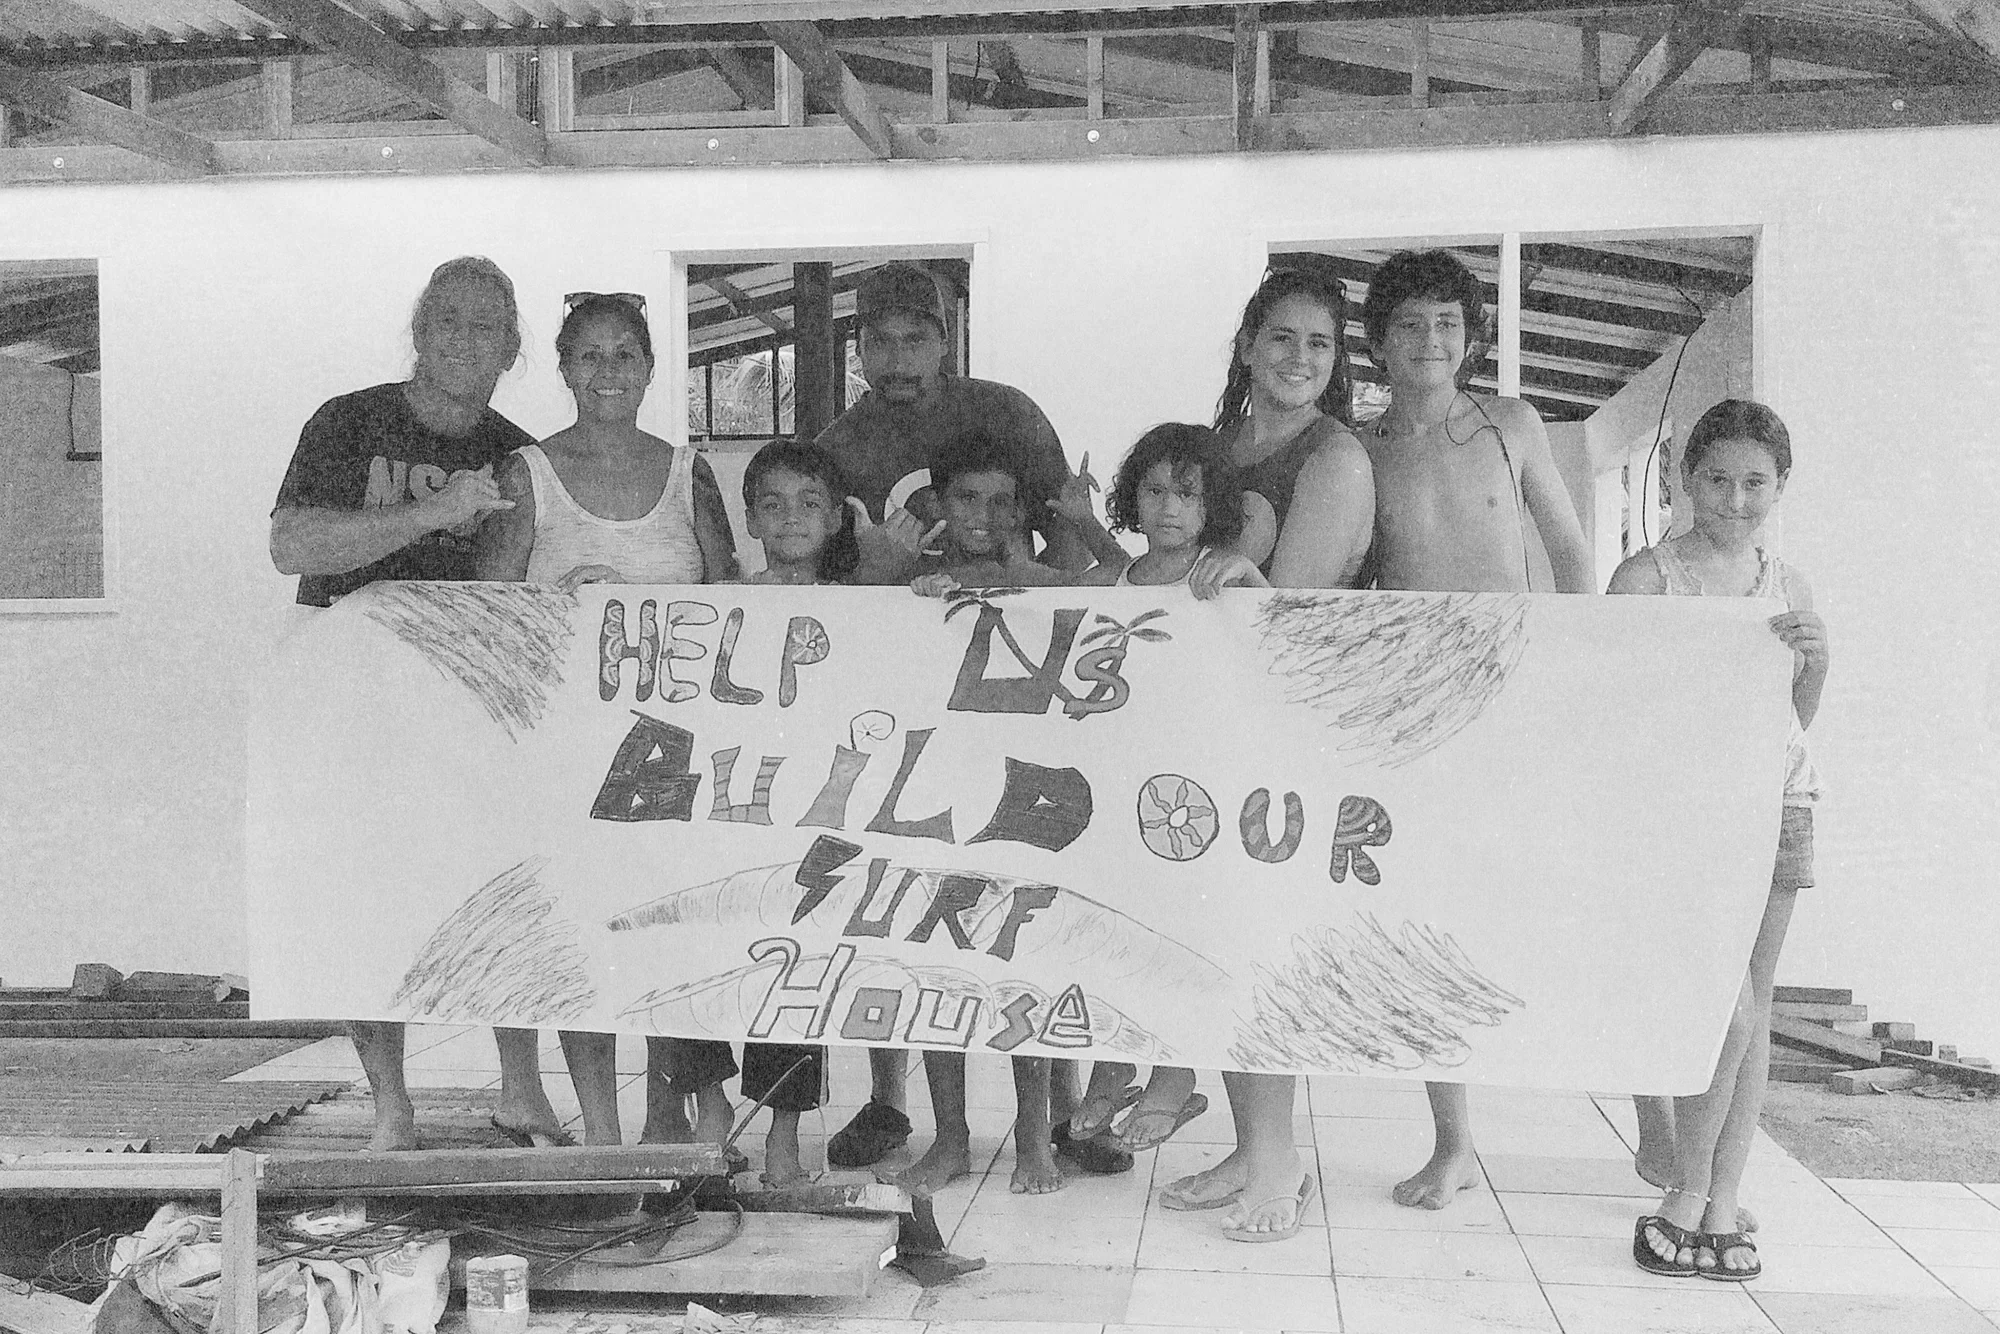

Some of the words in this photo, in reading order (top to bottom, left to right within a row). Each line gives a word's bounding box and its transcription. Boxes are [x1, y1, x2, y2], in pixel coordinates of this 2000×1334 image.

[599, 599, 831, 707] HELP
[946, 604, 1130, 720] US
[1137, 773, 1393, 886] OUR
[791, 834, 1059, 961] SURF
